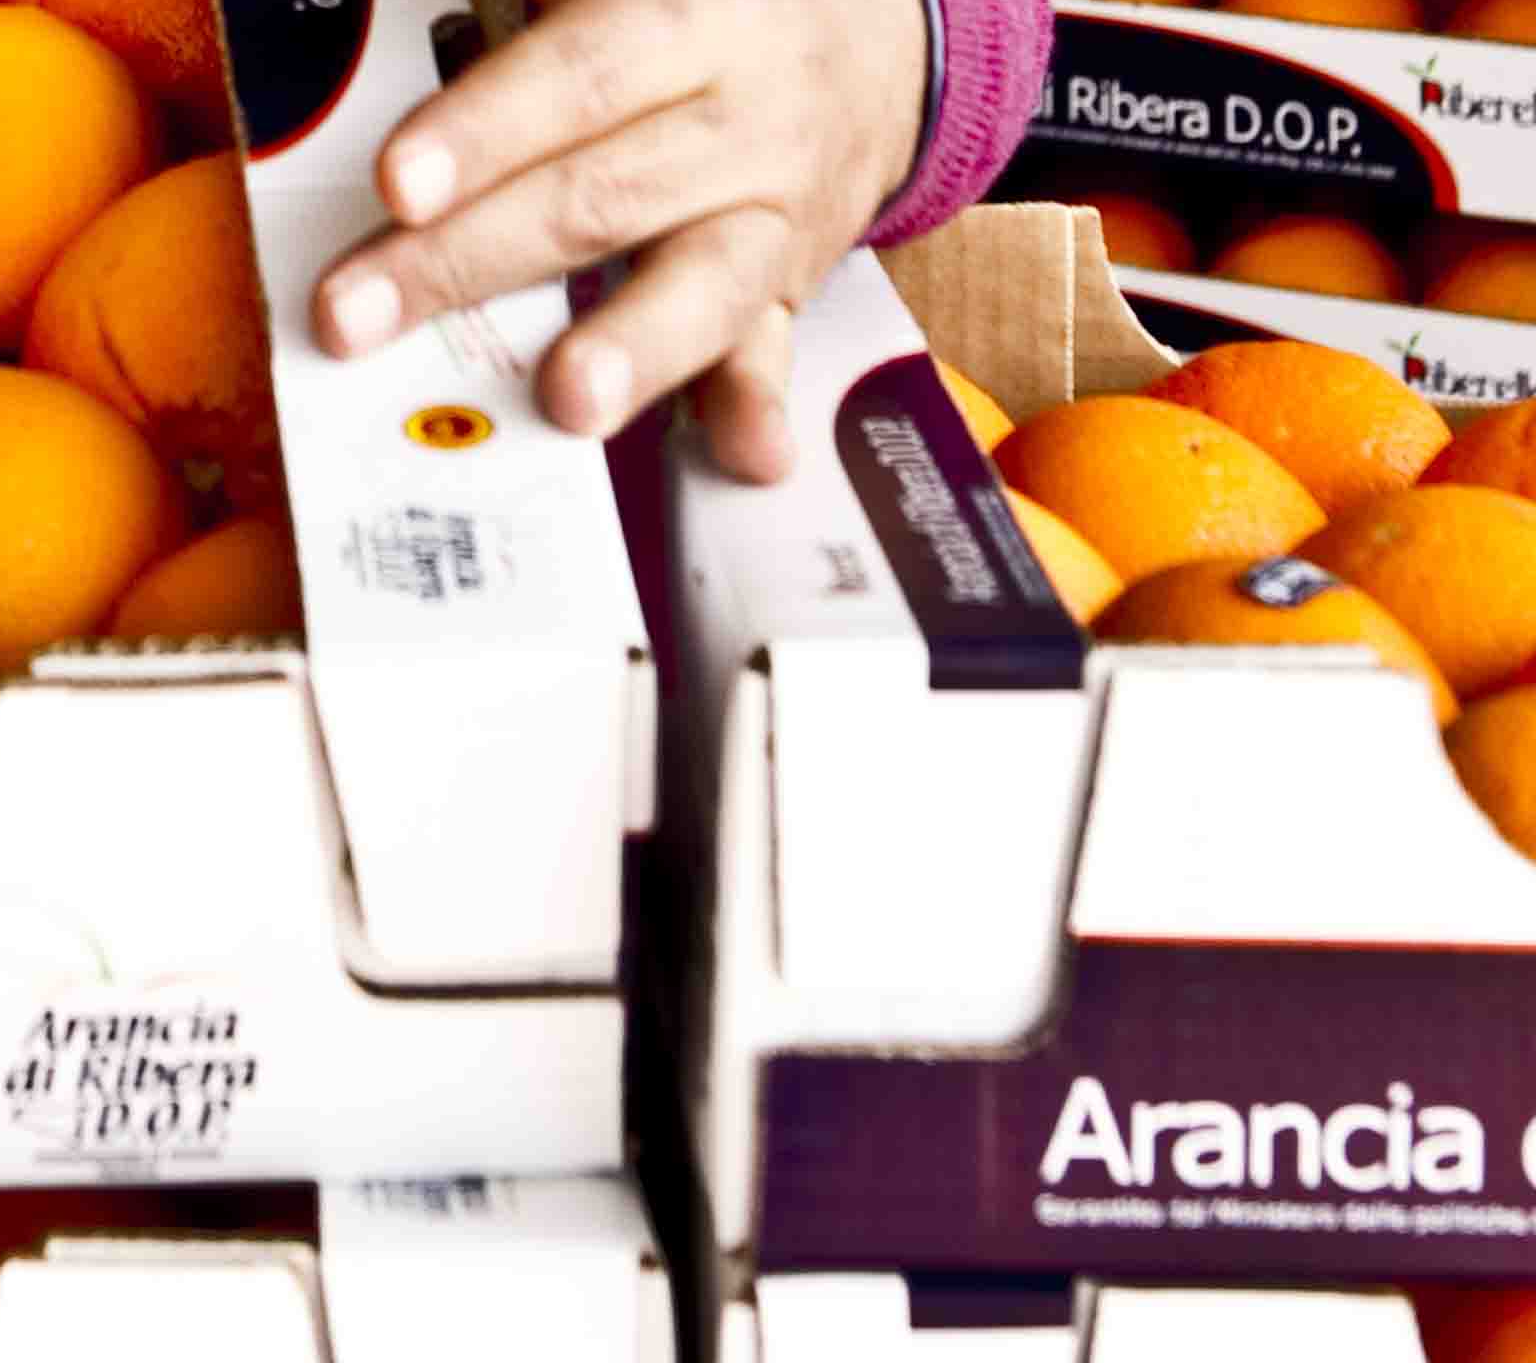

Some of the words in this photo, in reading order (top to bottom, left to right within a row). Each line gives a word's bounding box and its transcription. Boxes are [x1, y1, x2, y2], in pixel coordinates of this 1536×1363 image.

[1069, 76, 1209, 139] Ribera
[1226, 94, 1361, 155] D.O.P.
[26, 1006, 239, 1048] Arancia
[3, 1057, 56, 1095] di
[77, 1053, 258, 1095] Ribera
[1040, 1076, 1484, 1193] Arancia
